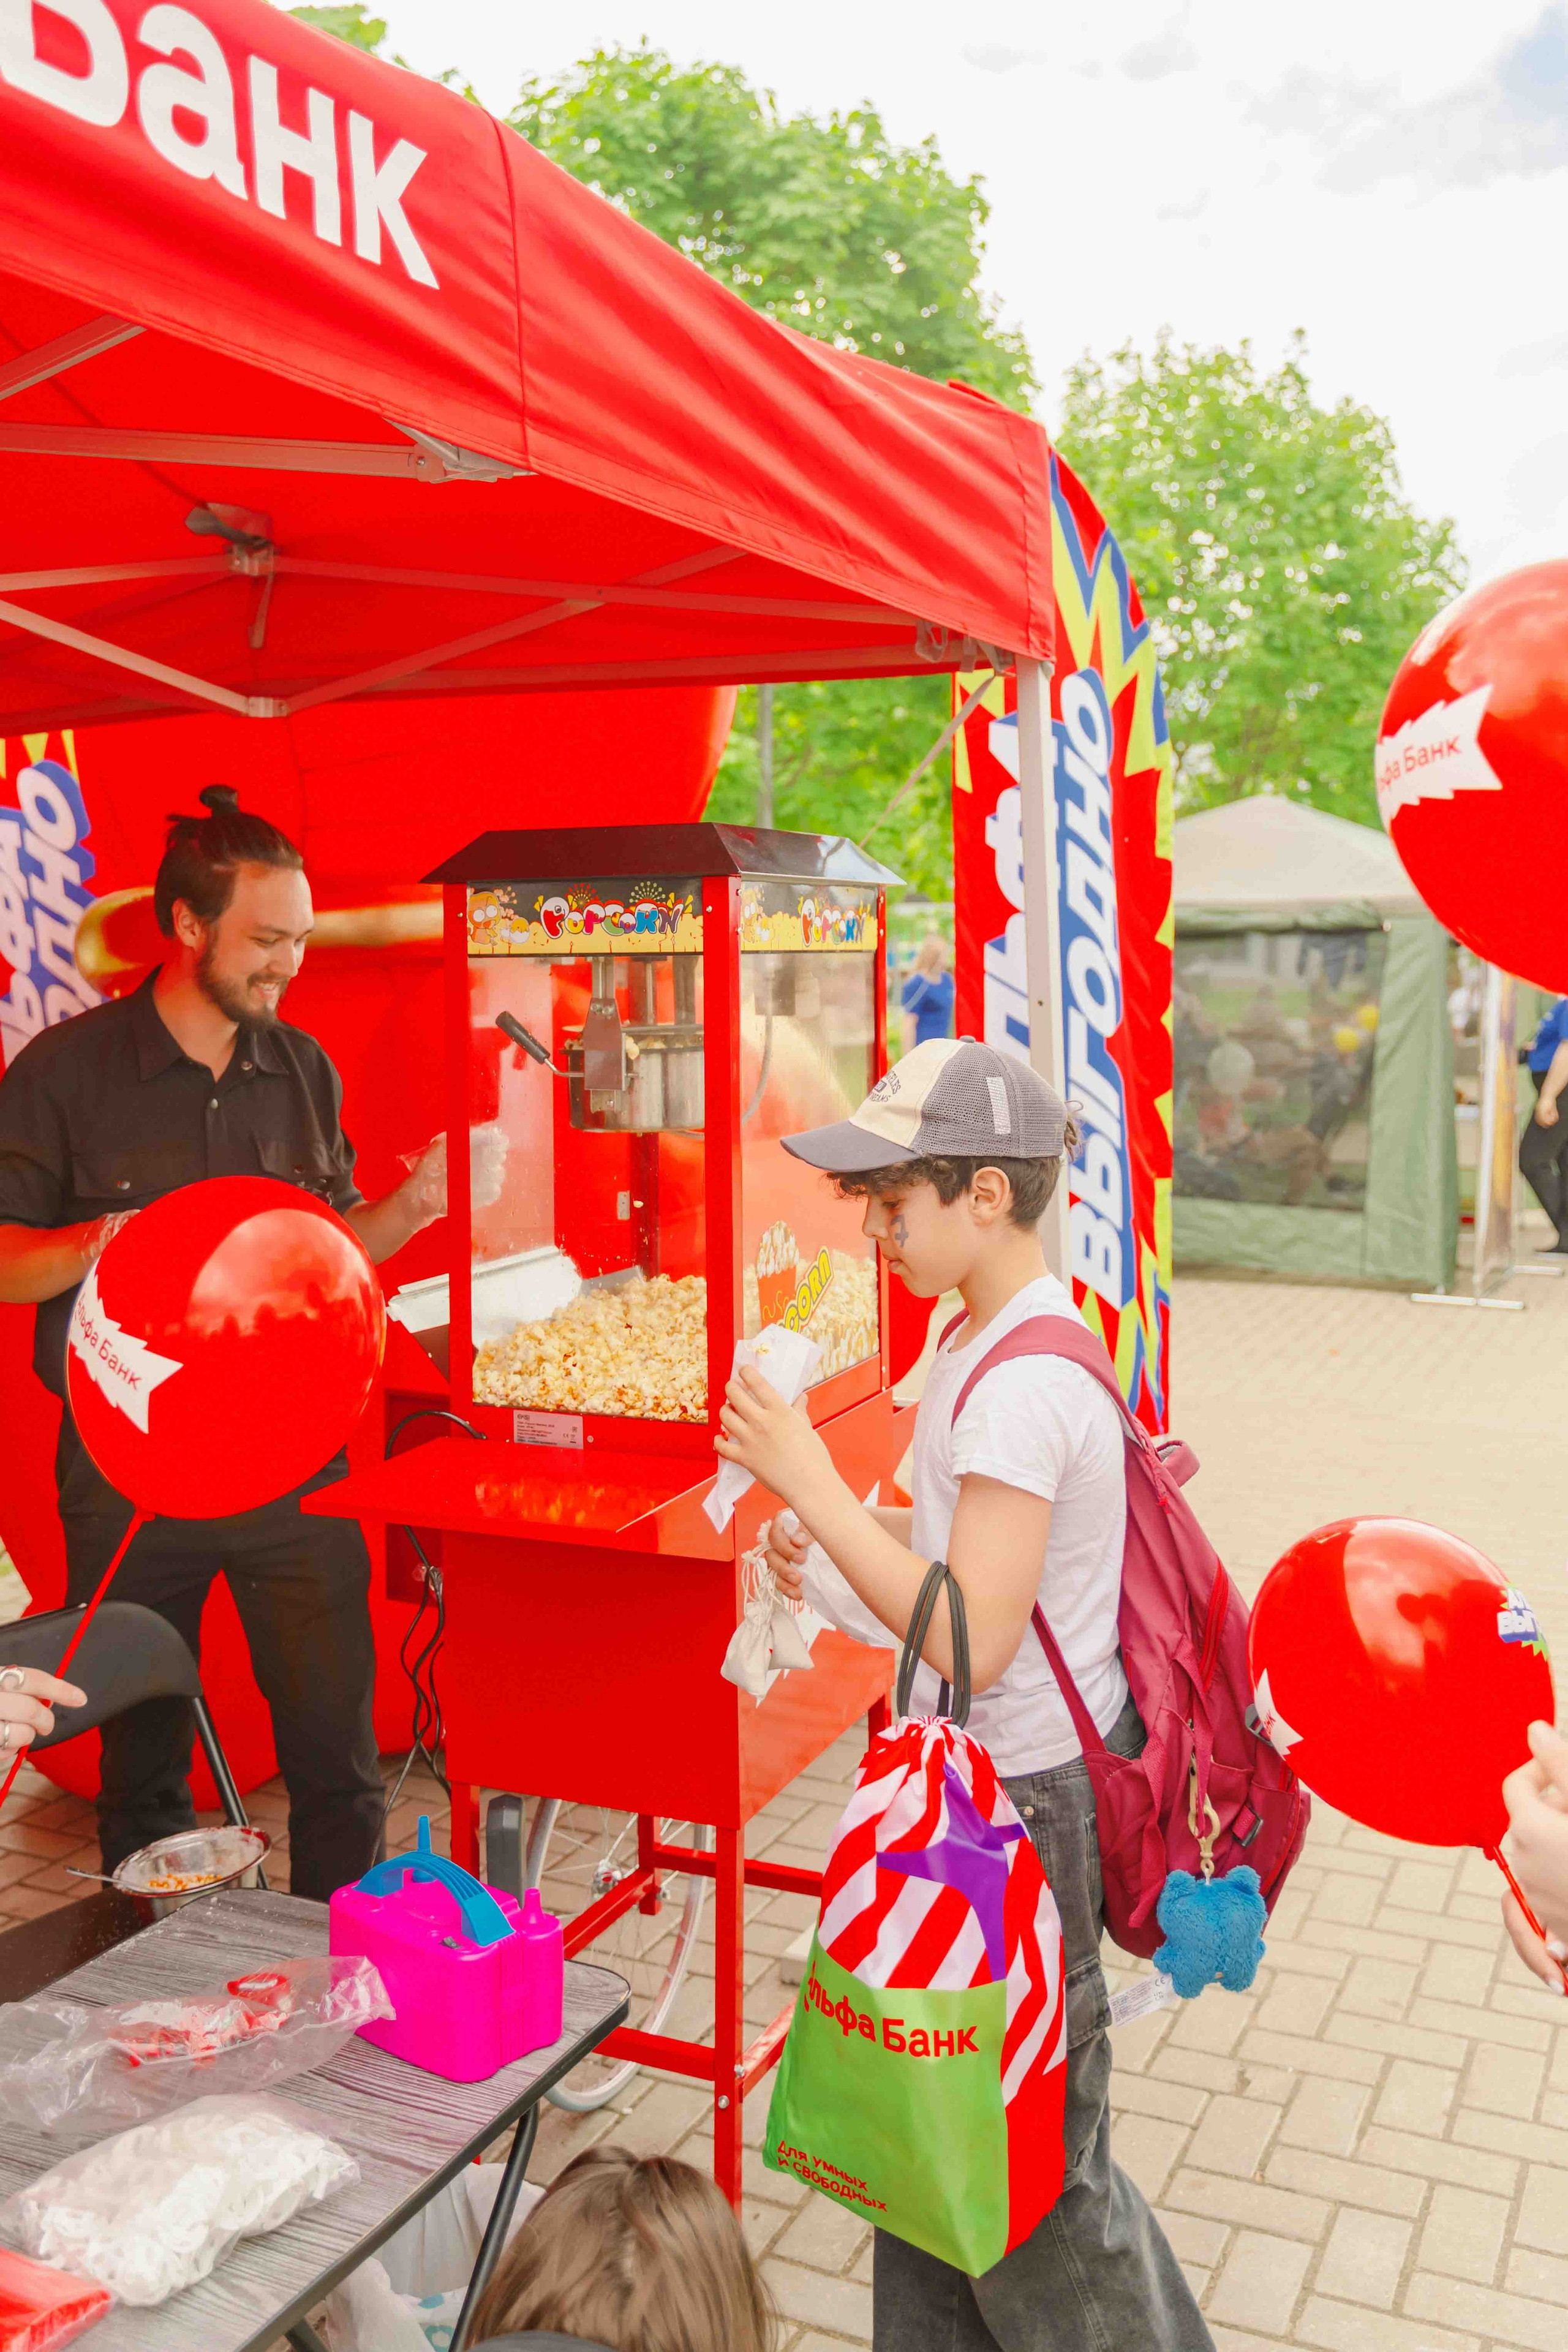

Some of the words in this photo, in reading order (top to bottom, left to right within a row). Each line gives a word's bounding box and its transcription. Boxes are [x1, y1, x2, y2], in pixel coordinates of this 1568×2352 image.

[1060, 673, 1123, 1310] ВЫГОДНО
[98, 1338, 143, 1391] Банк
[882, 2017, 980, 2058] Банк
